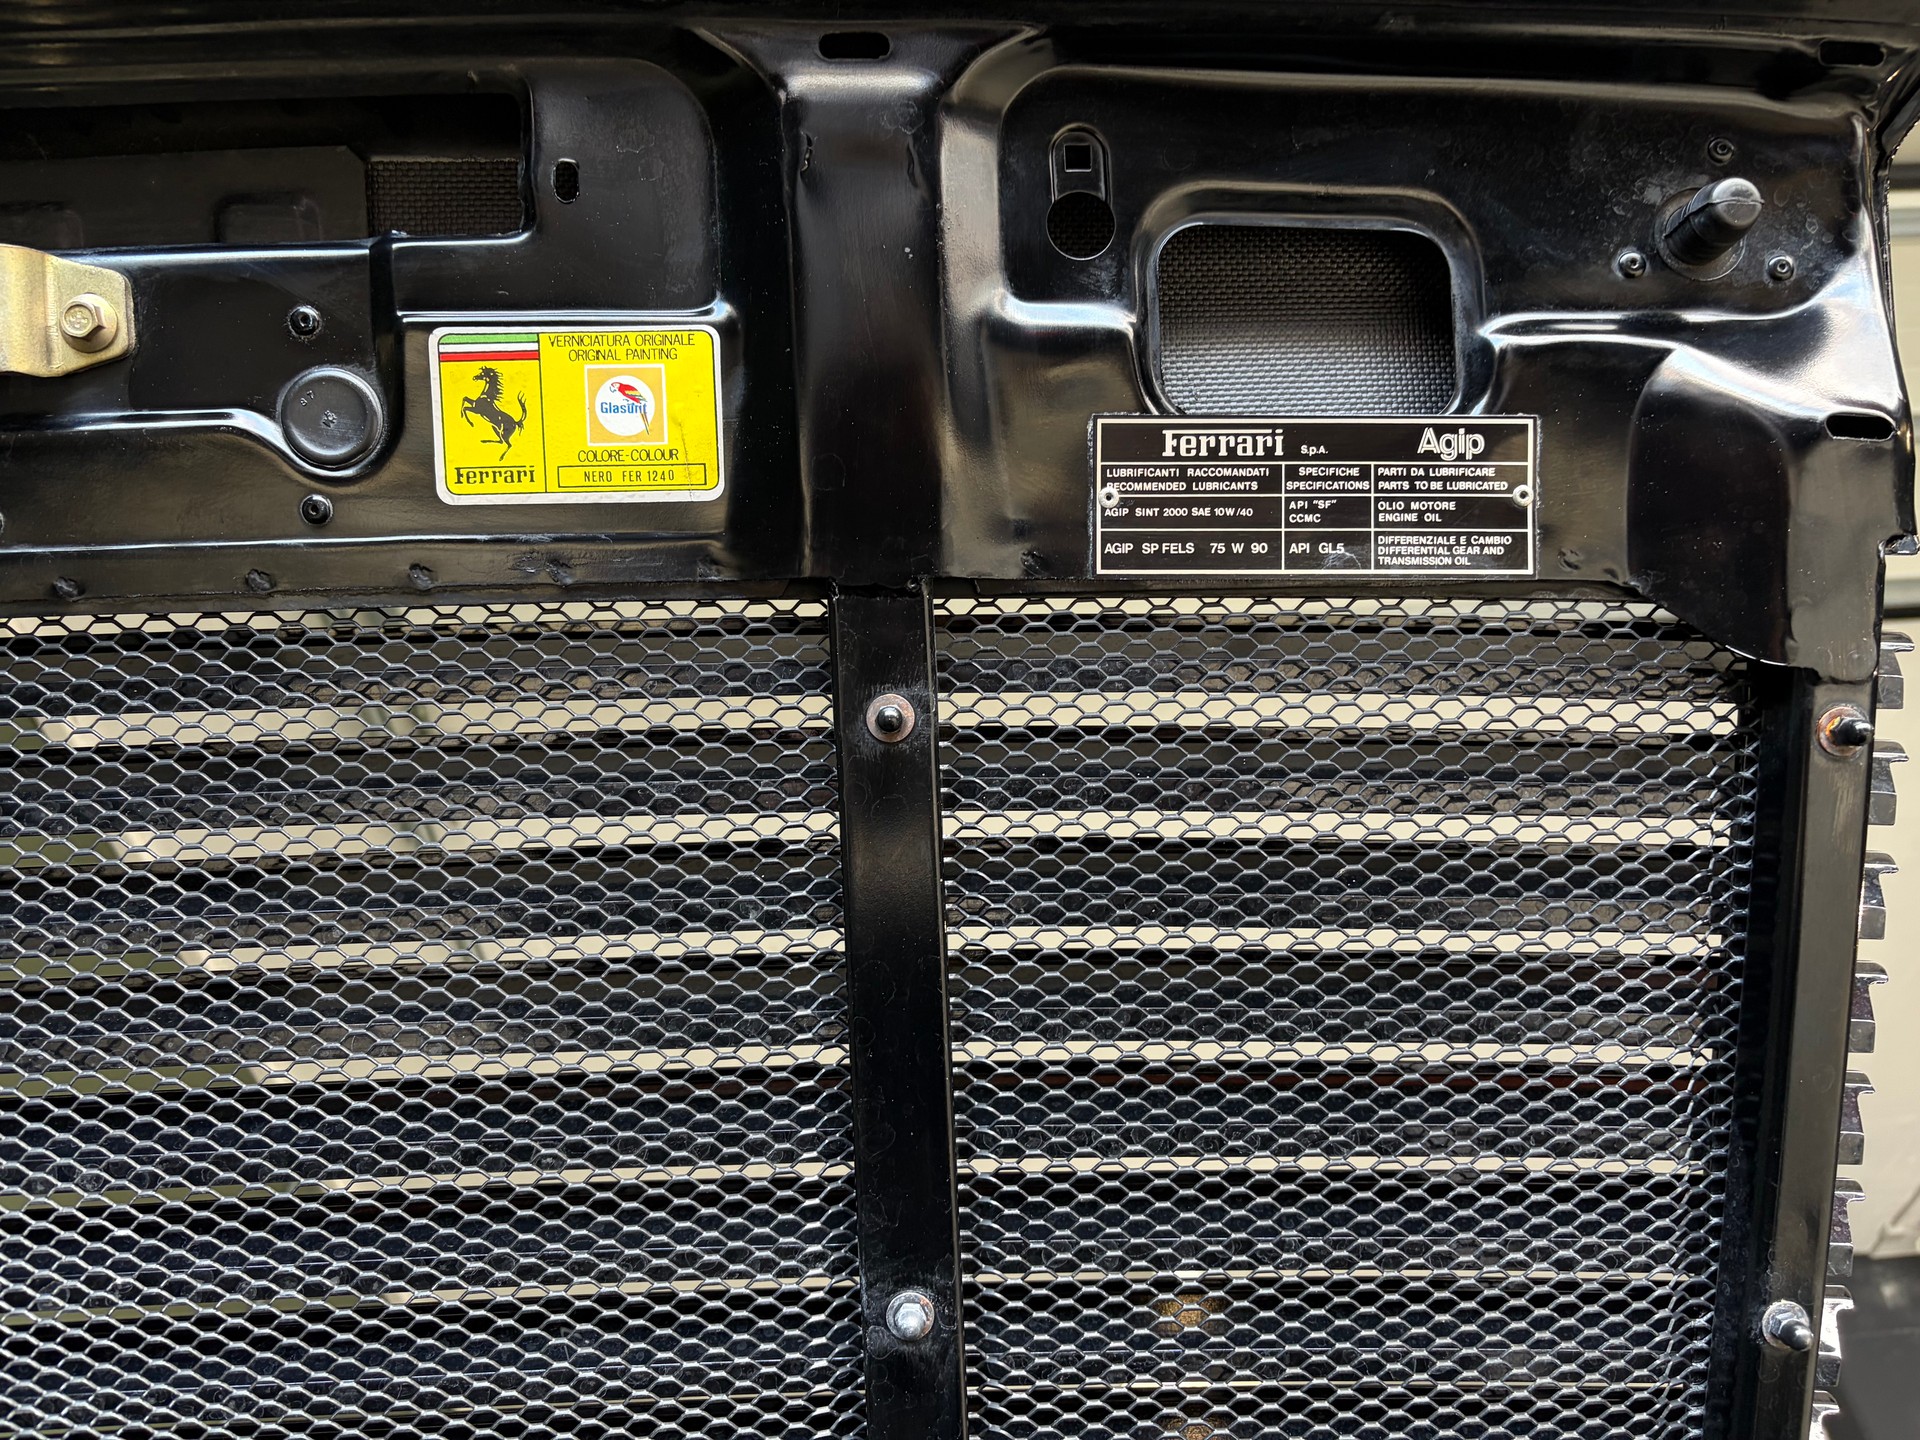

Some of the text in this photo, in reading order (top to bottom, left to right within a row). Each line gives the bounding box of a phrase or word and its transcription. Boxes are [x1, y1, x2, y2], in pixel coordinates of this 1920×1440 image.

[549, 334, 695, 347] VERNICIATURA ORIGINALE
[569, 348, 678, 361] ORIGINAL PAINTING
[600, 402, 647, 414] Glasurit
[1162, 429, 1328, 456] Ferrari S.p.A.
[1417, 427, 1485, 460] Agip
[454, 465, 535, 485] Ferrari
[584, 470, 675, 482] NERO FER 1240
[1107, 468, 1269, 477] LUBRIFICANTI RACCOMANDATI
[1299, 467, 1360, 476] SPECIFICHE
[1378, 468, 1495, 477] PARTI DA LUBRIFICARE
[1193, 482, 1258, 491] LUBRICANTS
[1286, 481, 1370, 490] SPECIFICATIONS
[1378, 481, 1508, 490] PARTS TO BE LUBRICATED
[1289, 500, 1337, 509] API "SF"
[1378, 501, 1456, 510] OLIO MOTORE
[1105, 508, 1129, 517] AGIP
[1135, 508, 1159, 517] SINT
[1163, 508, 1188, 517] 2000
[1192, 508, 1211, 516] SAE
[1289, 514, 1321, 523] CCMC
[1379, 513, 1442, 522] ENGINE OIL
[1378, 536, 1512, 545] DIFFERENZIALE E CAMBIO
[1104, 543, 1133, 554] AGIP
[1210, 543, 1226, 554] 75
[1231, 543, 1244, 553] W
[1251, 543, 1268, 554] 90
[1289, 543, 1344, 554] API GL5
[1378, 546, 1504, 555] DIFFERENTIAL GEAR AND
[1378, 557, 1471, 566] TRANSMISSION OIL
